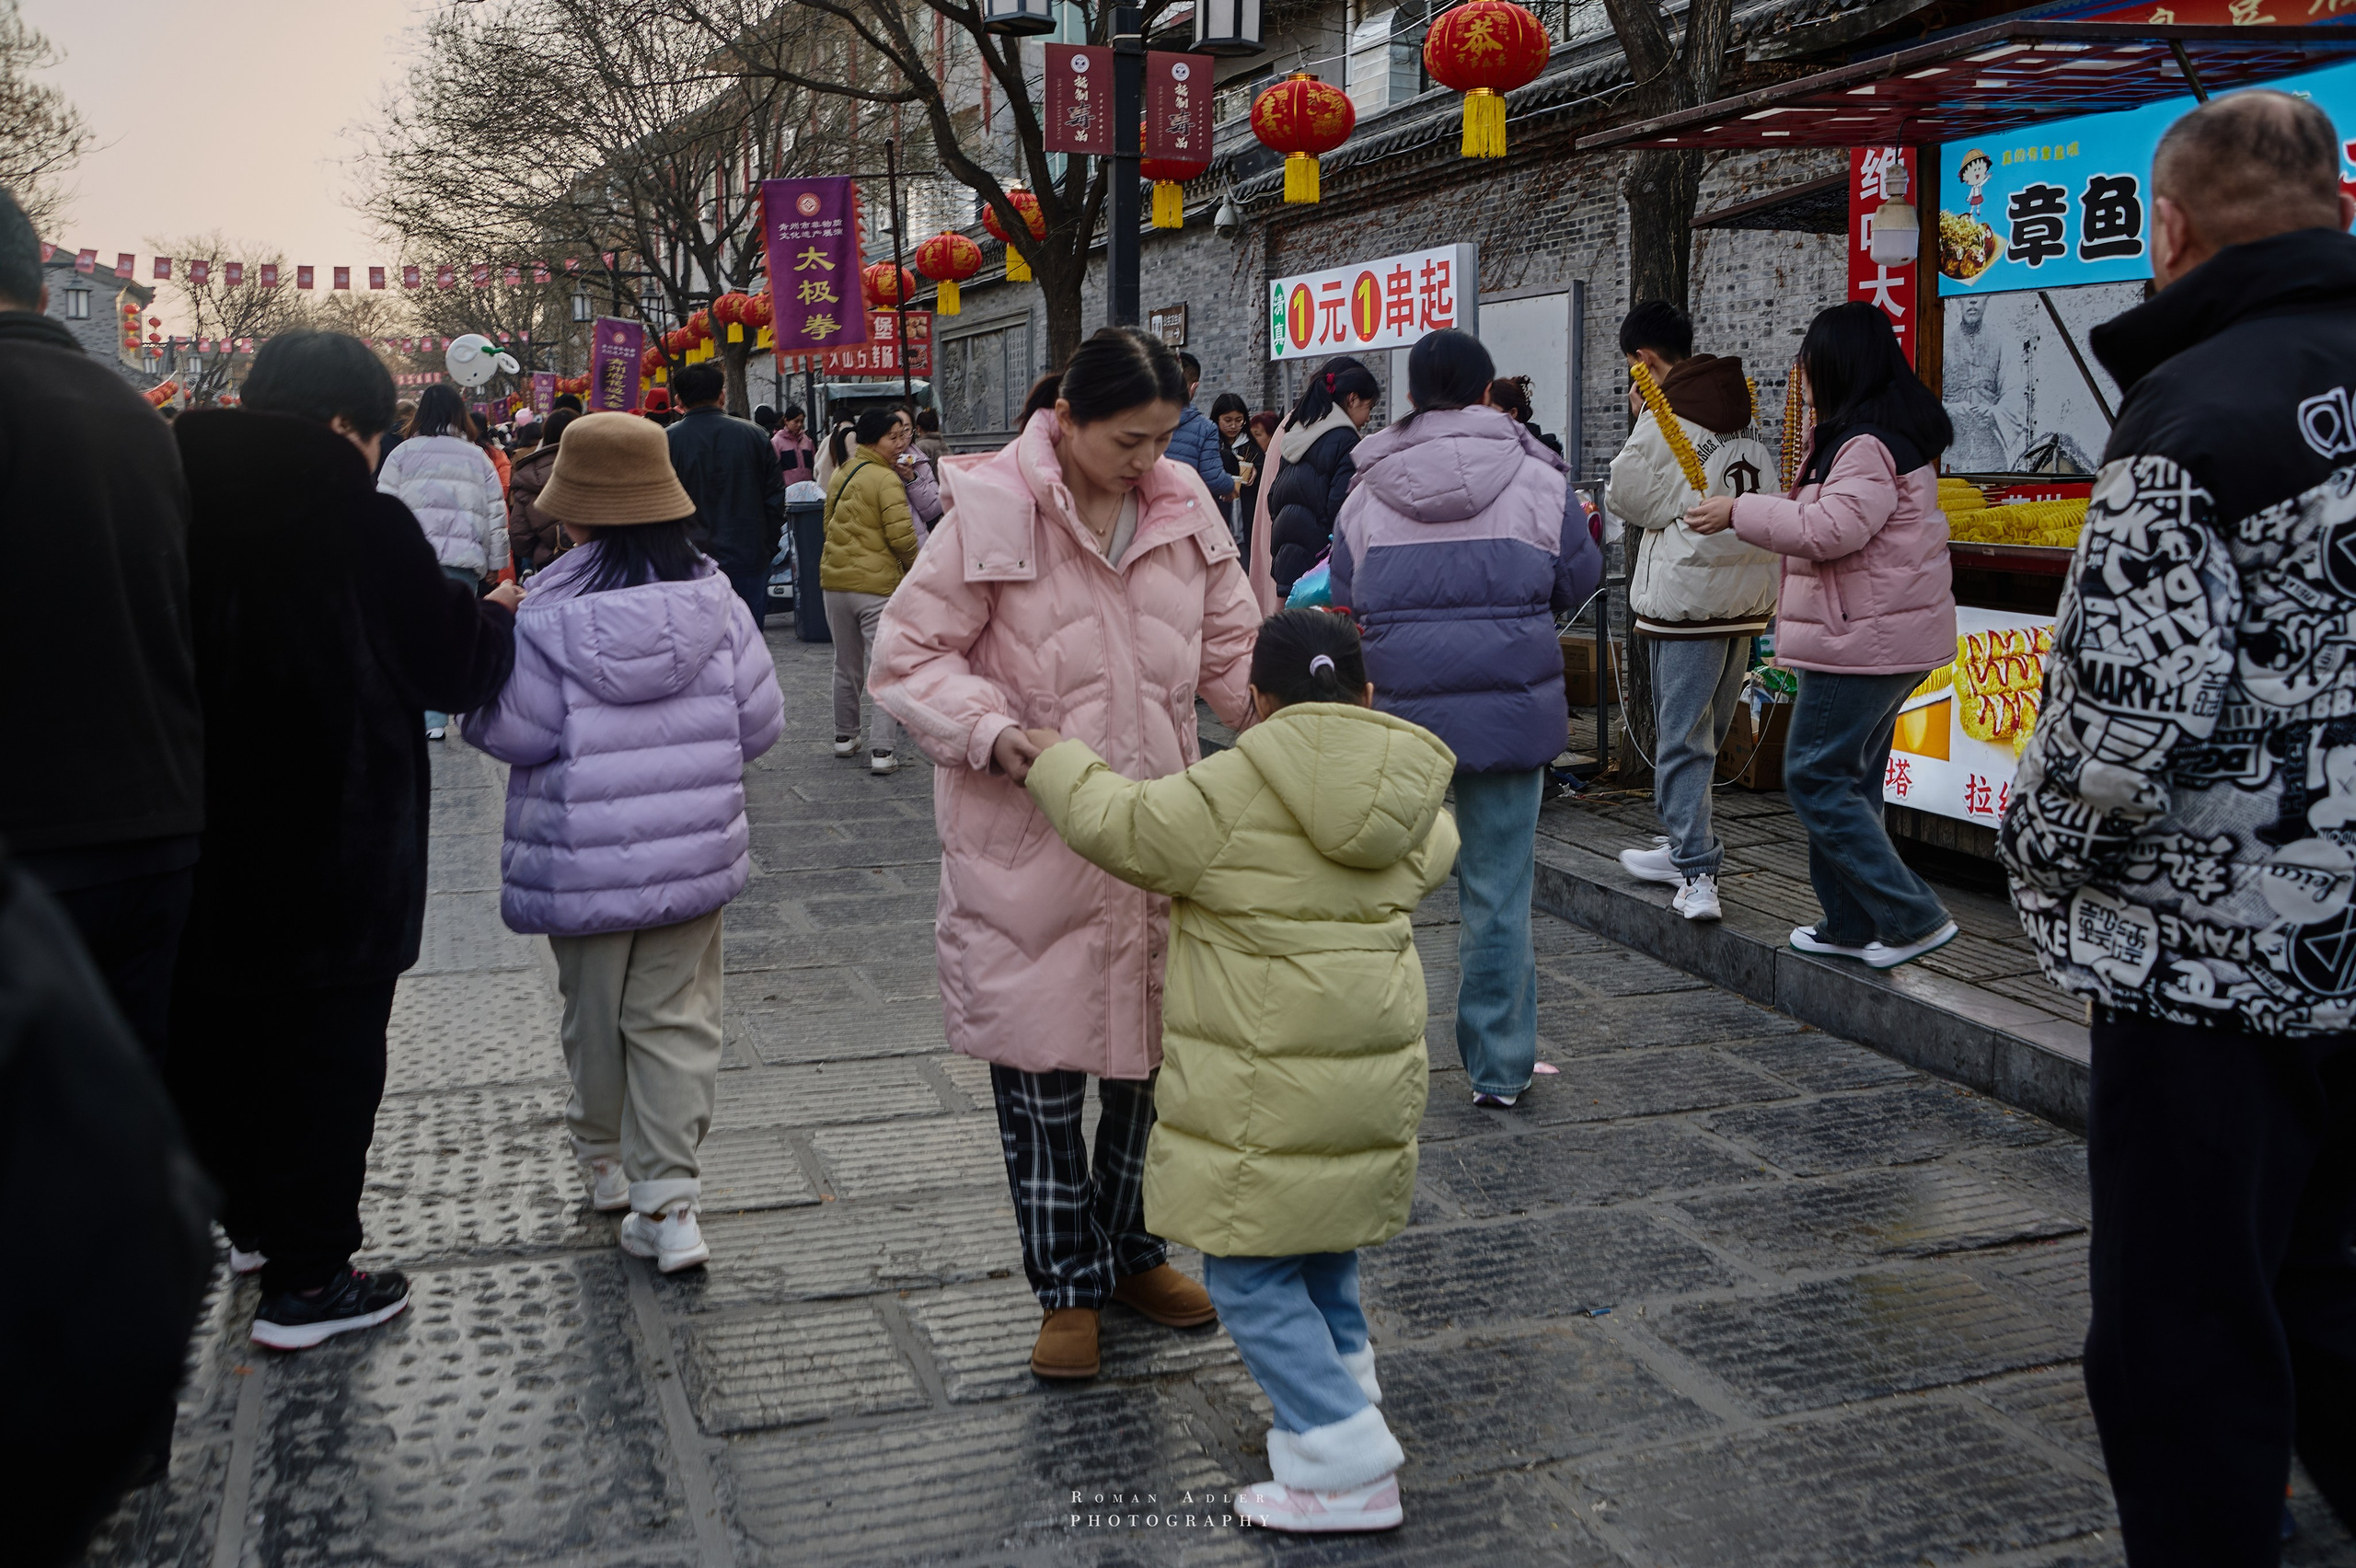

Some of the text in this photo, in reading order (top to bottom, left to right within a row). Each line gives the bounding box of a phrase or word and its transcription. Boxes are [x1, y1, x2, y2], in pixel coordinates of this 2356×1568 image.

[2007, 174, 2144, 268] 章鱼
[792, 245, 843, 340] 太极拳
[1273, 292, 1285, 346] 清真
[1292, 259, 1454, 346] 1元1串起
[2159, 914, 2252, 961] FAKE
